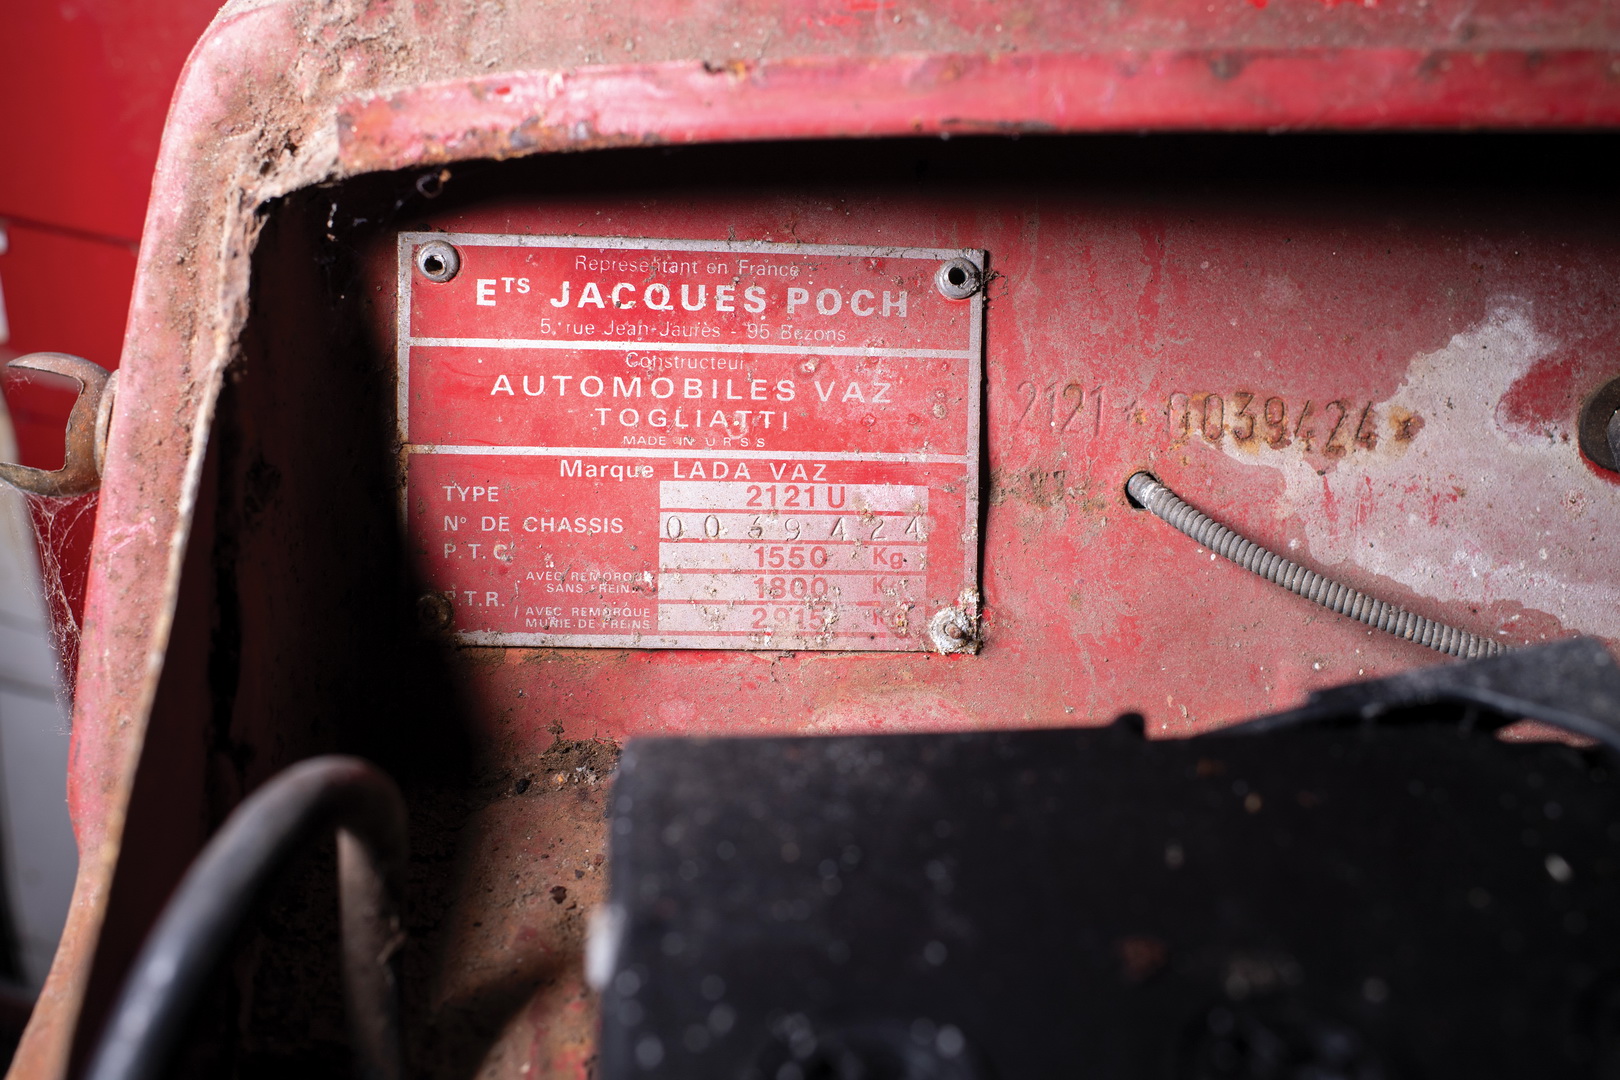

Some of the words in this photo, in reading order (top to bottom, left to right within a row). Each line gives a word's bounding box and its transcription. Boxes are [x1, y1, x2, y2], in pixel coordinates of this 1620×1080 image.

[706, 262, 728, 275] en
[739, 259, 799, 277] France
[549, 281, 766, 313] JACQUES
[786, 287, 908, 318] POCH
[566, 326, 595, 335] rue
[747, 323, 770, 339] 95
[780, 325, 846, 341] Bezons
[625, 352, 744, 370] Constructeur
[490, 374, 796, 402] AUTOMOBILES
[814, 381, 891, 403] VAZ
[595, 407, 788, 429] TOGLIATTI
[623, 435, 666, 446] MADE
[560, 459, 654, 482] Marque
[673, 461, 751, 480] LADA
[769, 462, 827, 481] VAZ
[442, 485, 499, 502] TYPE
[746, 485, 846, 508] 2121U
[444, 515, 467, 531] N°
[481, 516, 510, 532] DE
[523, 516, 624, 534] CHASSIS
[754, 546, 828, 568] 1550
[872, 547, 903, 569] Kg
[526, 571, 562, 581] AVEC
[571, 572, 652, 583] REMORQU
[546, 583, 583, 593] SANS
[754, 576, 829, 599] 1800
[525, 606, 562, 617] AVEC
[571, 607, 651, 618] REMORQUE
[525, 618, 572, 629] MUNIE
[578, 619, 596, 629] DE
[602, 620, 651, 630] FREINS
